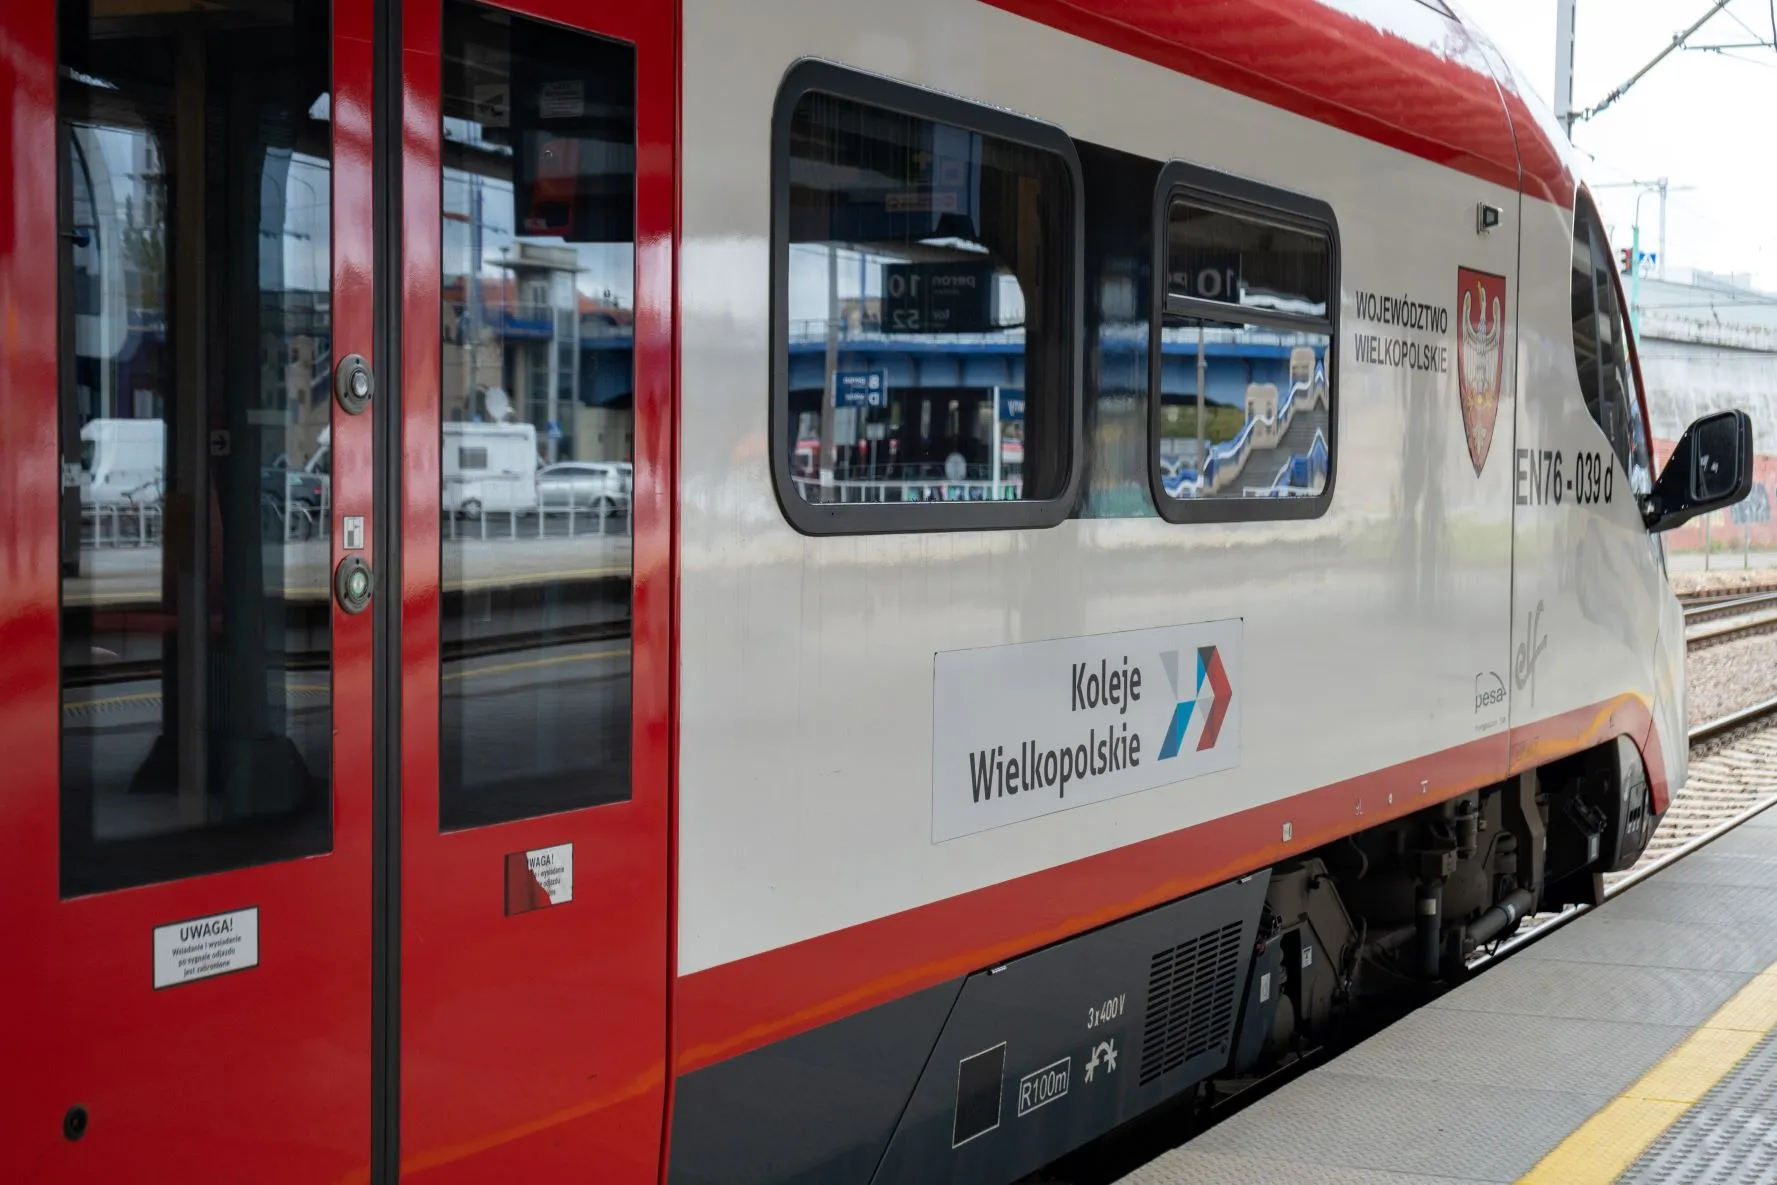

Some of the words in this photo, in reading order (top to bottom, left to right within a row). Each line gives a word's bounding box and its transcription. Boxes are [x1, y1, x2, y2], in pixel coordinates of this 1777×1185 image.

[1356, 290, 1448, 334] WOJEWÓDZTWO
[1355, 333, 1447, 373] WIELKOPOLSKIE
[1071, 655, 1142, 715] Koleje
[1475, 687, 1507, 714] pesa
[969, 722, 1141, 804] Wielkopolskie
[529, 854, 554, 868] WAGA!
[180, 917, 233, 942] UWAGA!
[1021, 1070, 1067, 1110] R100m
